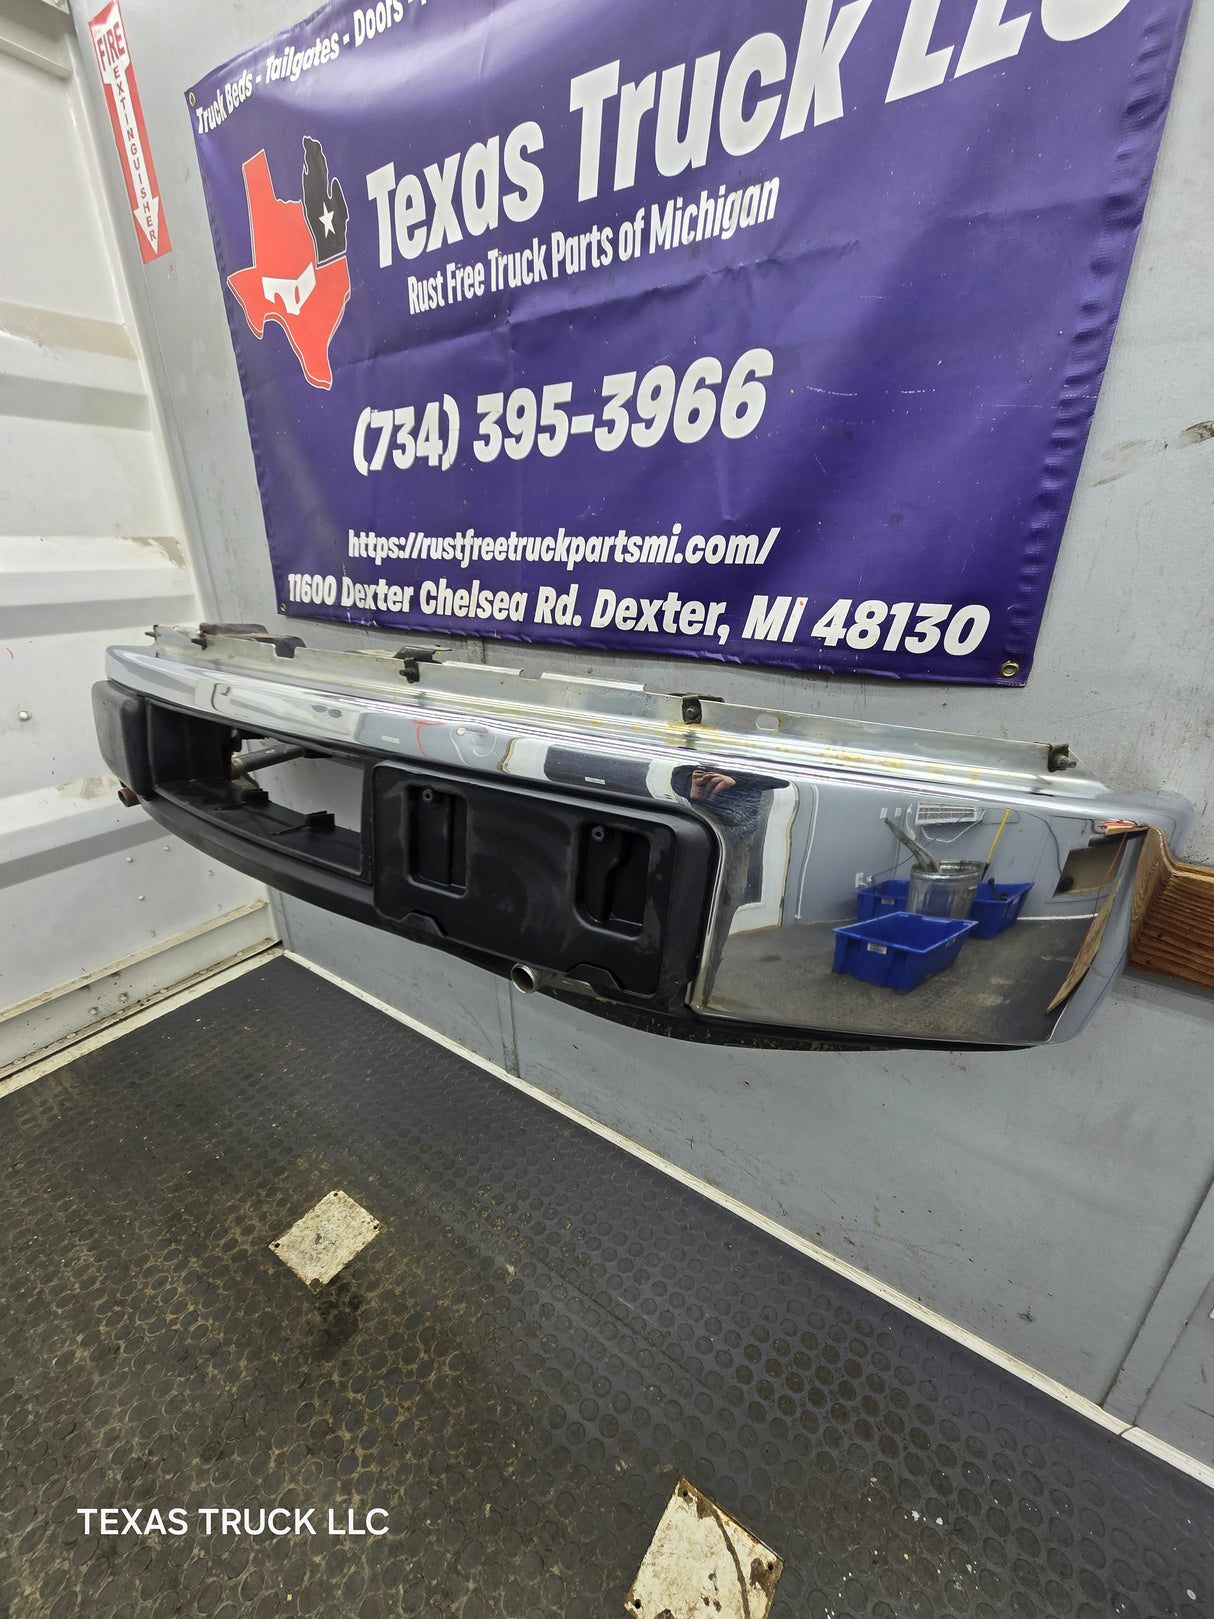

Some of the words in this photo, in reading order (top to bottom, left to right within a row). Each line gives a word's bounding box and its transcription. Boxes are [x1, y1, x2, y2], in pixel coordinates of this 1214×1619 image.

[97, 21, 126, 72] FIRE
[196, 89, 227, 134] Truck
[225, 69, 253, 114] Beds
[265, 32, 340, 84] Tailgates
[353, 0, 404, 47] Doors
[113, 66, 157, 242] EXTINGUISHER
[366, 121, 545, 268] Texas
[569, 0, 873, 202] Truck
[408, 270, 445, 315] Rust
[446, 262, 485, 304] Free
[488, 237, 548, 292] Truck
[551, 224, 614, 278] Parts
[618, 207, 645, 262] of
[649, 176, 780, 254] Michigan
[353, 394, 460, 476] (734)
[473, 348, 774, 463] 395-3966
[348, 523, 781, 570] https://rustfreetruckpartsmi.com/
[288, 573, 337, 606] 11600
[341, 576, 414, 613] Dexter
[420, 578, 525, 622] Chelsea
[534, 583, 582, 627] Rd.
[590, 588, 730, 645] Dexter,
[742, 594, 808, 643] MI
[810, 598, 991, 656] 48130
